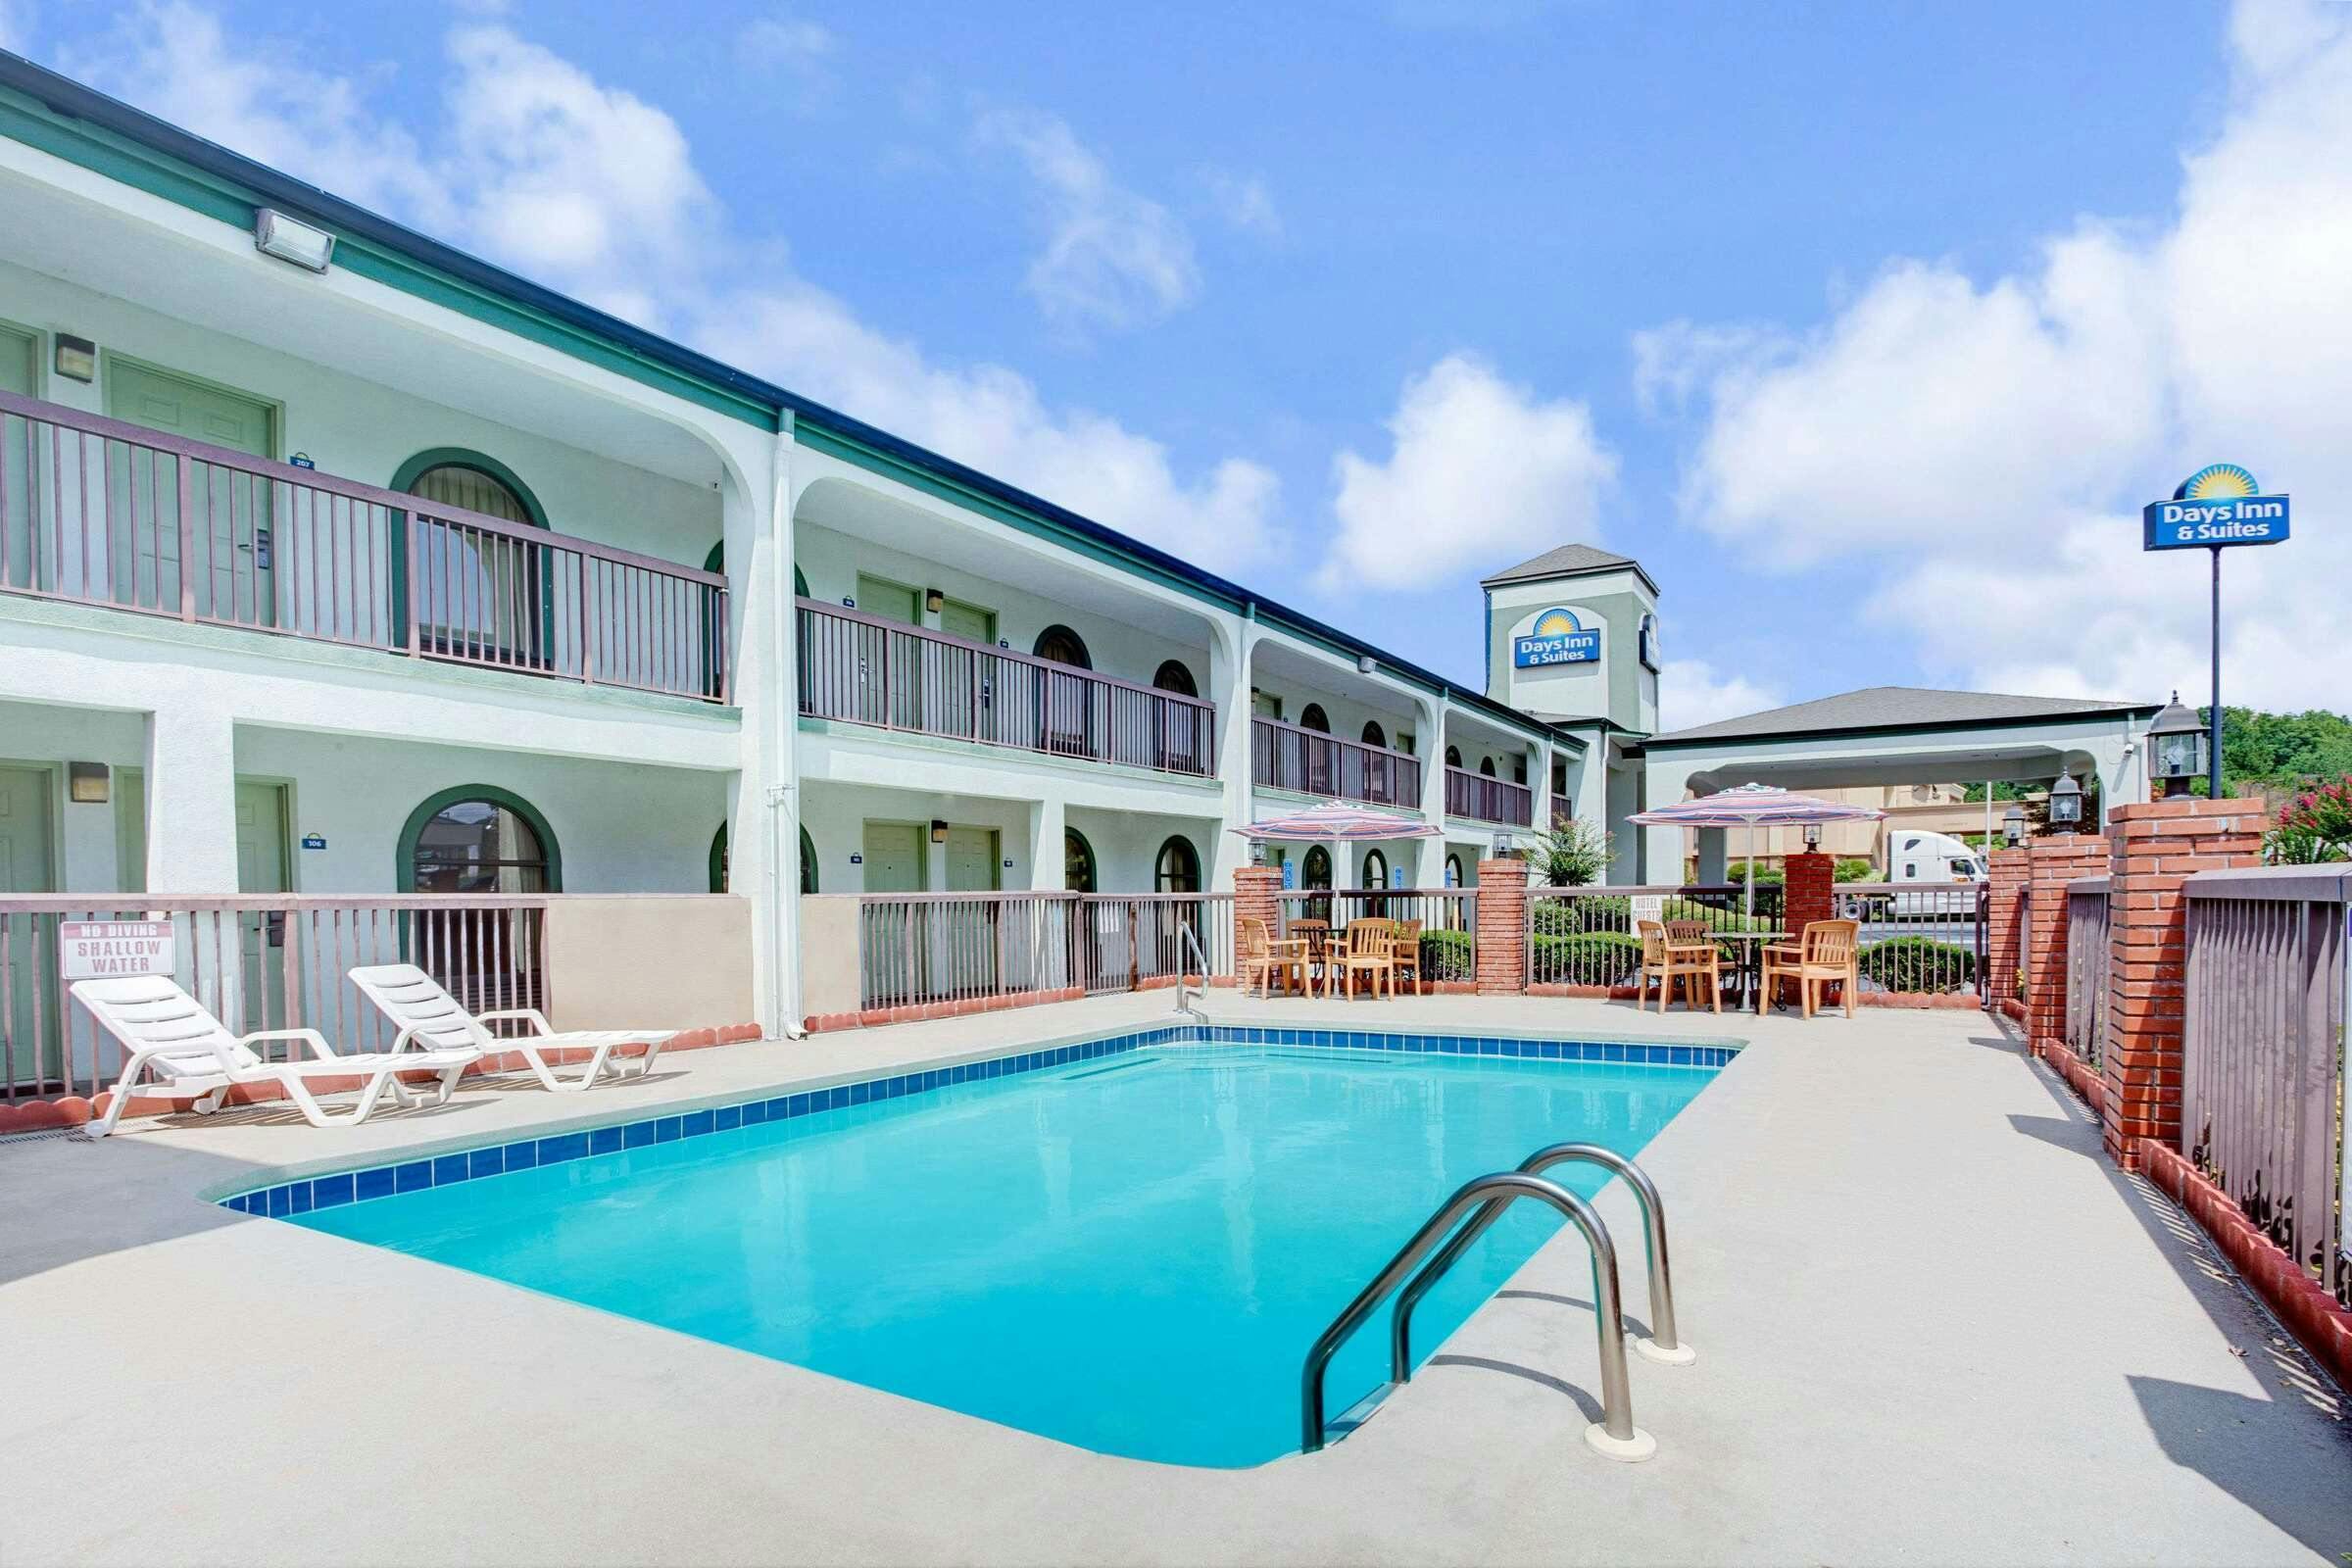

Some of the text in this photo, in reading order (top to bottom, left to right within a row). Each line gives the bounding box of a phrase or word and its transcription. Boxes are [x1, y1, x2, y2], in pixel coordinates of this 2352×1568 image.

[2163, 502, 2282, 524] Days Inn
[2177, 521, 2271, 540] & Suites
[1520, 636, 1593, 654] Days Inn
[1529, 650, 1586, 664] & Suites
[80, 924, 158, 937] NO DIVING
[77, 940, 161, 956] SHALLOW
[92, 957, 150, 972] WATER
